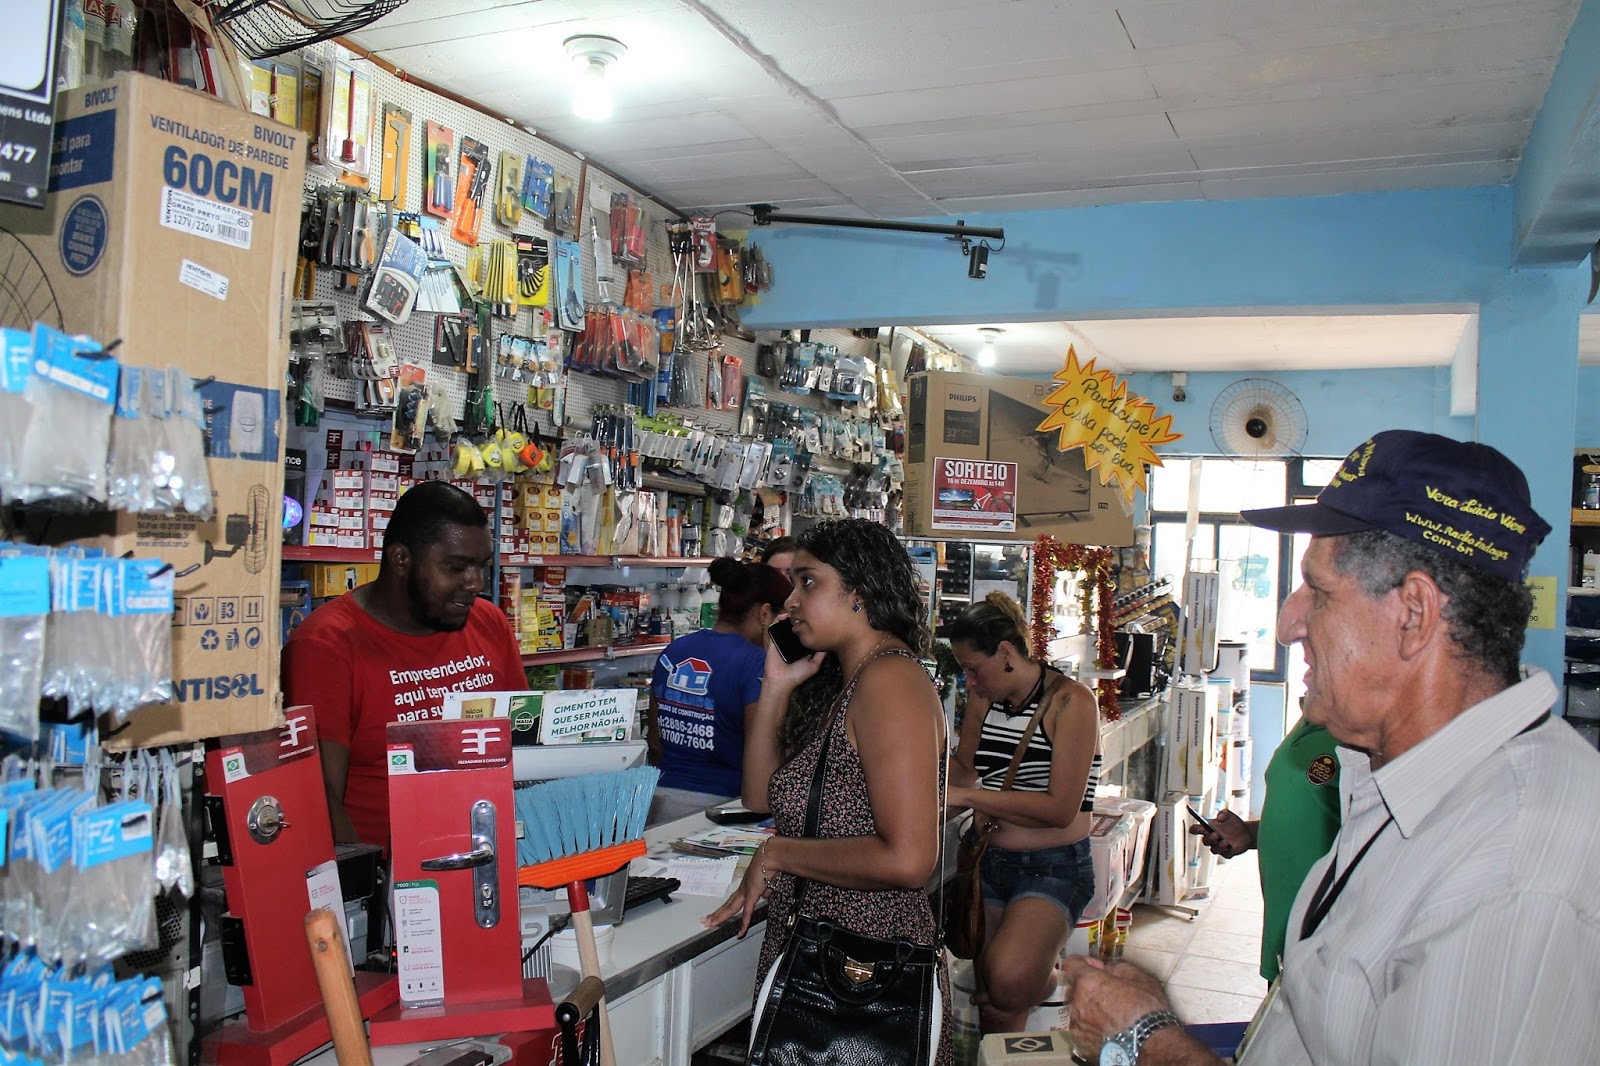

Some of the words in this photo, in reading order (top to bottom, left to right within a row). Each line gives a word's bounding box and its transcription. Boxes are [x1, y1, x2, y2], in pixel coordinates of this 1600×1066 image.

[85, 86, 118, 108] BIVOLT
[25, 108, 51, 125] Ltda
[69, 134, 91, 154] para
[150, 114, 225, 150] VENTILADOR
[228, 139, 244, 156] DE
[246, 146, 289, 170] PAREDE
[254, 125, 296, 151] BIVOLT
[163, 145, 274, 214] 60CM
[171, 201, 195, 213] GRADE
[197, 209, 220, 221] PRETO
[173, 214, 215, 234] 127V/220V
[949, 393, 977, 402] PHILIPS
[1081, 378, 1160, 441] Participe!
[1062, 397, 1097, 431] Essa
[1096, 427, 1128, 452] pode
[945, 461, 1007, 480] SORTEIO
[960, 478, 988, 486] DEZEMBRO
[1426, 485, 1459, 509] Vera
[389, 654, 491, 685] Empreendedor,
[394, 687, 426, 707] aqui
[426, 686, 449, 699] tem
[452, 673, 494, 693] crédito
[397, 708, 429, 723] para
[553, 716, 572, 725] QUE
[573, 713, 591, 722] SER
[592, 706, 620, 719] MAUÁ.
[554, 700, 596, 714] CIMENTO
[597, 697, 617, 706] TEM
[672, 706, 678, 714] DE
[678, 709, 715, 721] CONSTRUÇÃO
[551, 723, 590, 736] MELHOR
[591, 719, 611, 729] NÃO
[612, 715, 628, 724] HÁ.
[88, 819, 115, 844] FZ
